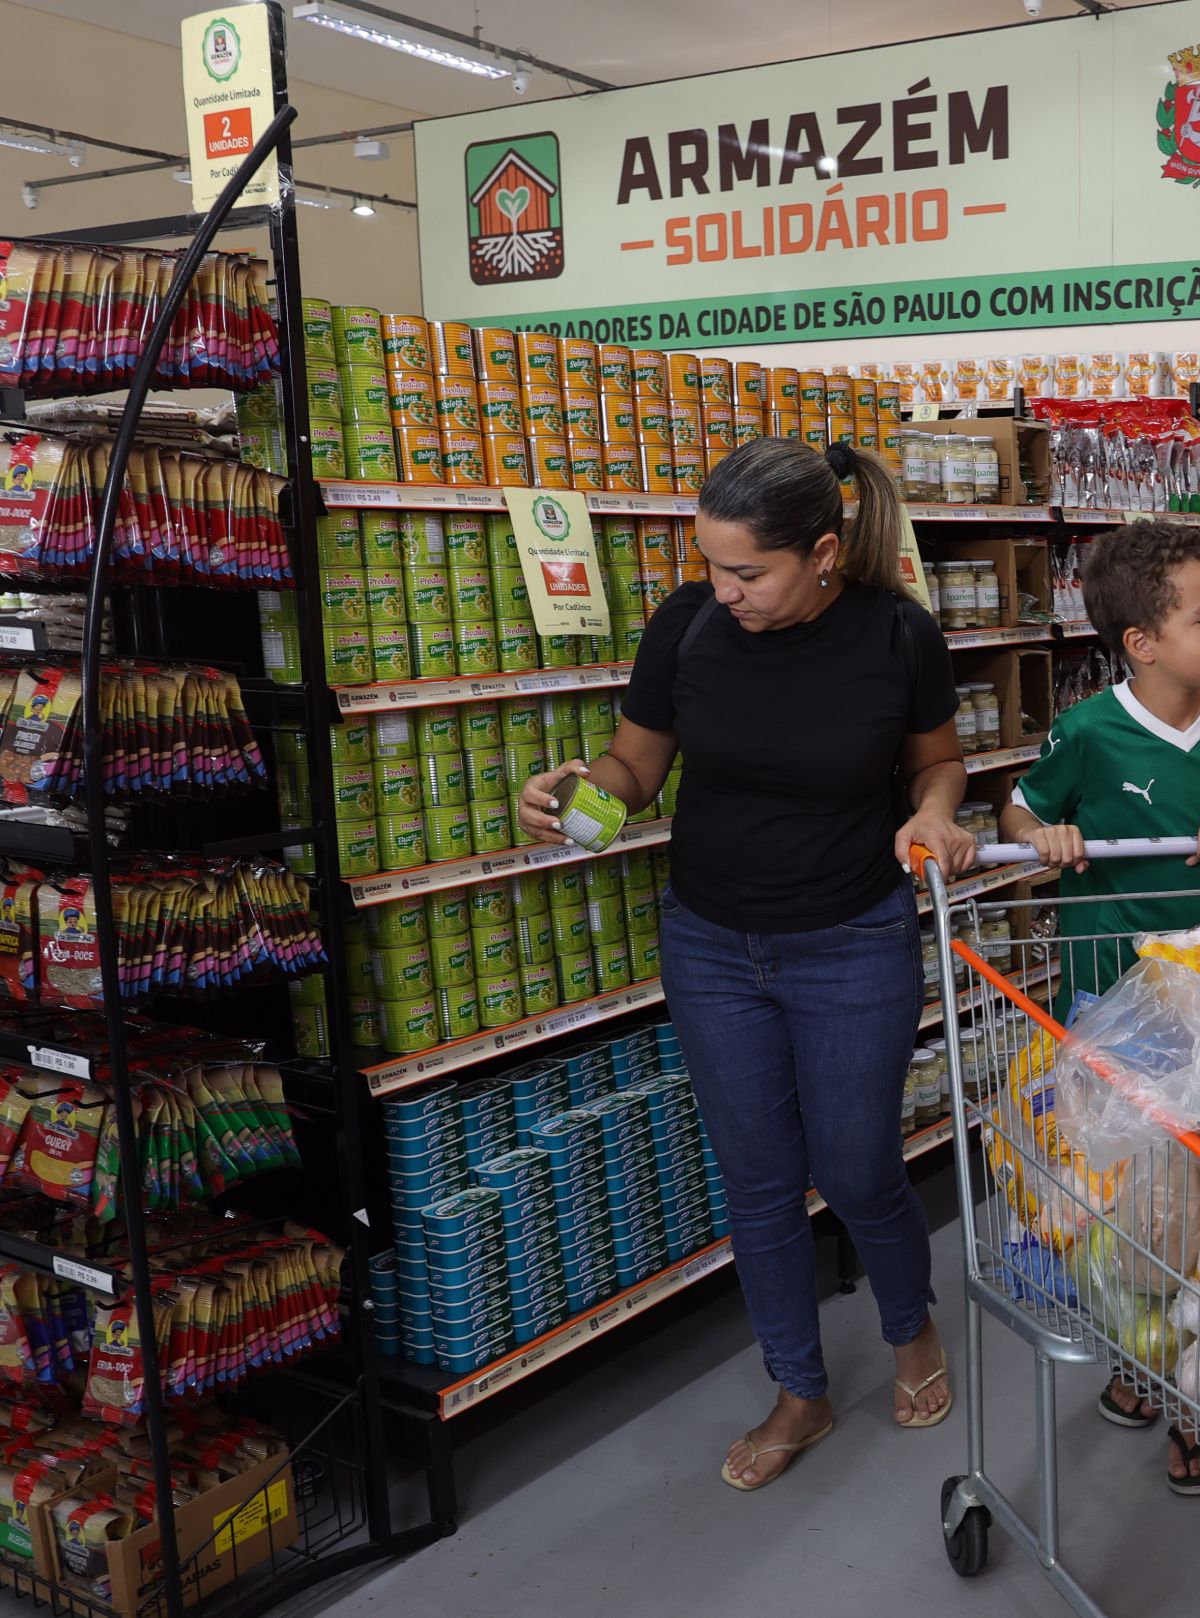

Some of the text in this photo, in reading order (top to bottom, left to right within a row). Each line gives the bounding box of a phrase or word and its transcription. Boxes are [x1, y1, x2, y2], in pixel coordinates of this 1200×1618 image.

[193, 87, 261, 108] Quantidade Limitada
[221, 116, 232, 138] 2
[208, 136, 249, 153] UNIDADES
[616, 77, 1009, 205] ARMAZÉM
[209, 167, 221, 179] Por
[665, 183, 949, 266] SOLIDÁRIO
[659, 312, 682, 340] DA
[698, 305, 786, 337] CIDADE
[794, 302, 827, 329] DE
[833, 291, 885, 328] SÃO
[894, 289, 981, 323] PAULO
[990, 285, 1054, 318] COM
[549, 582, 588, 593] UNIDADES
[553, 602, 592, 612] Por CadÚnico
[44, 1134, 73, 1152] CURRY
